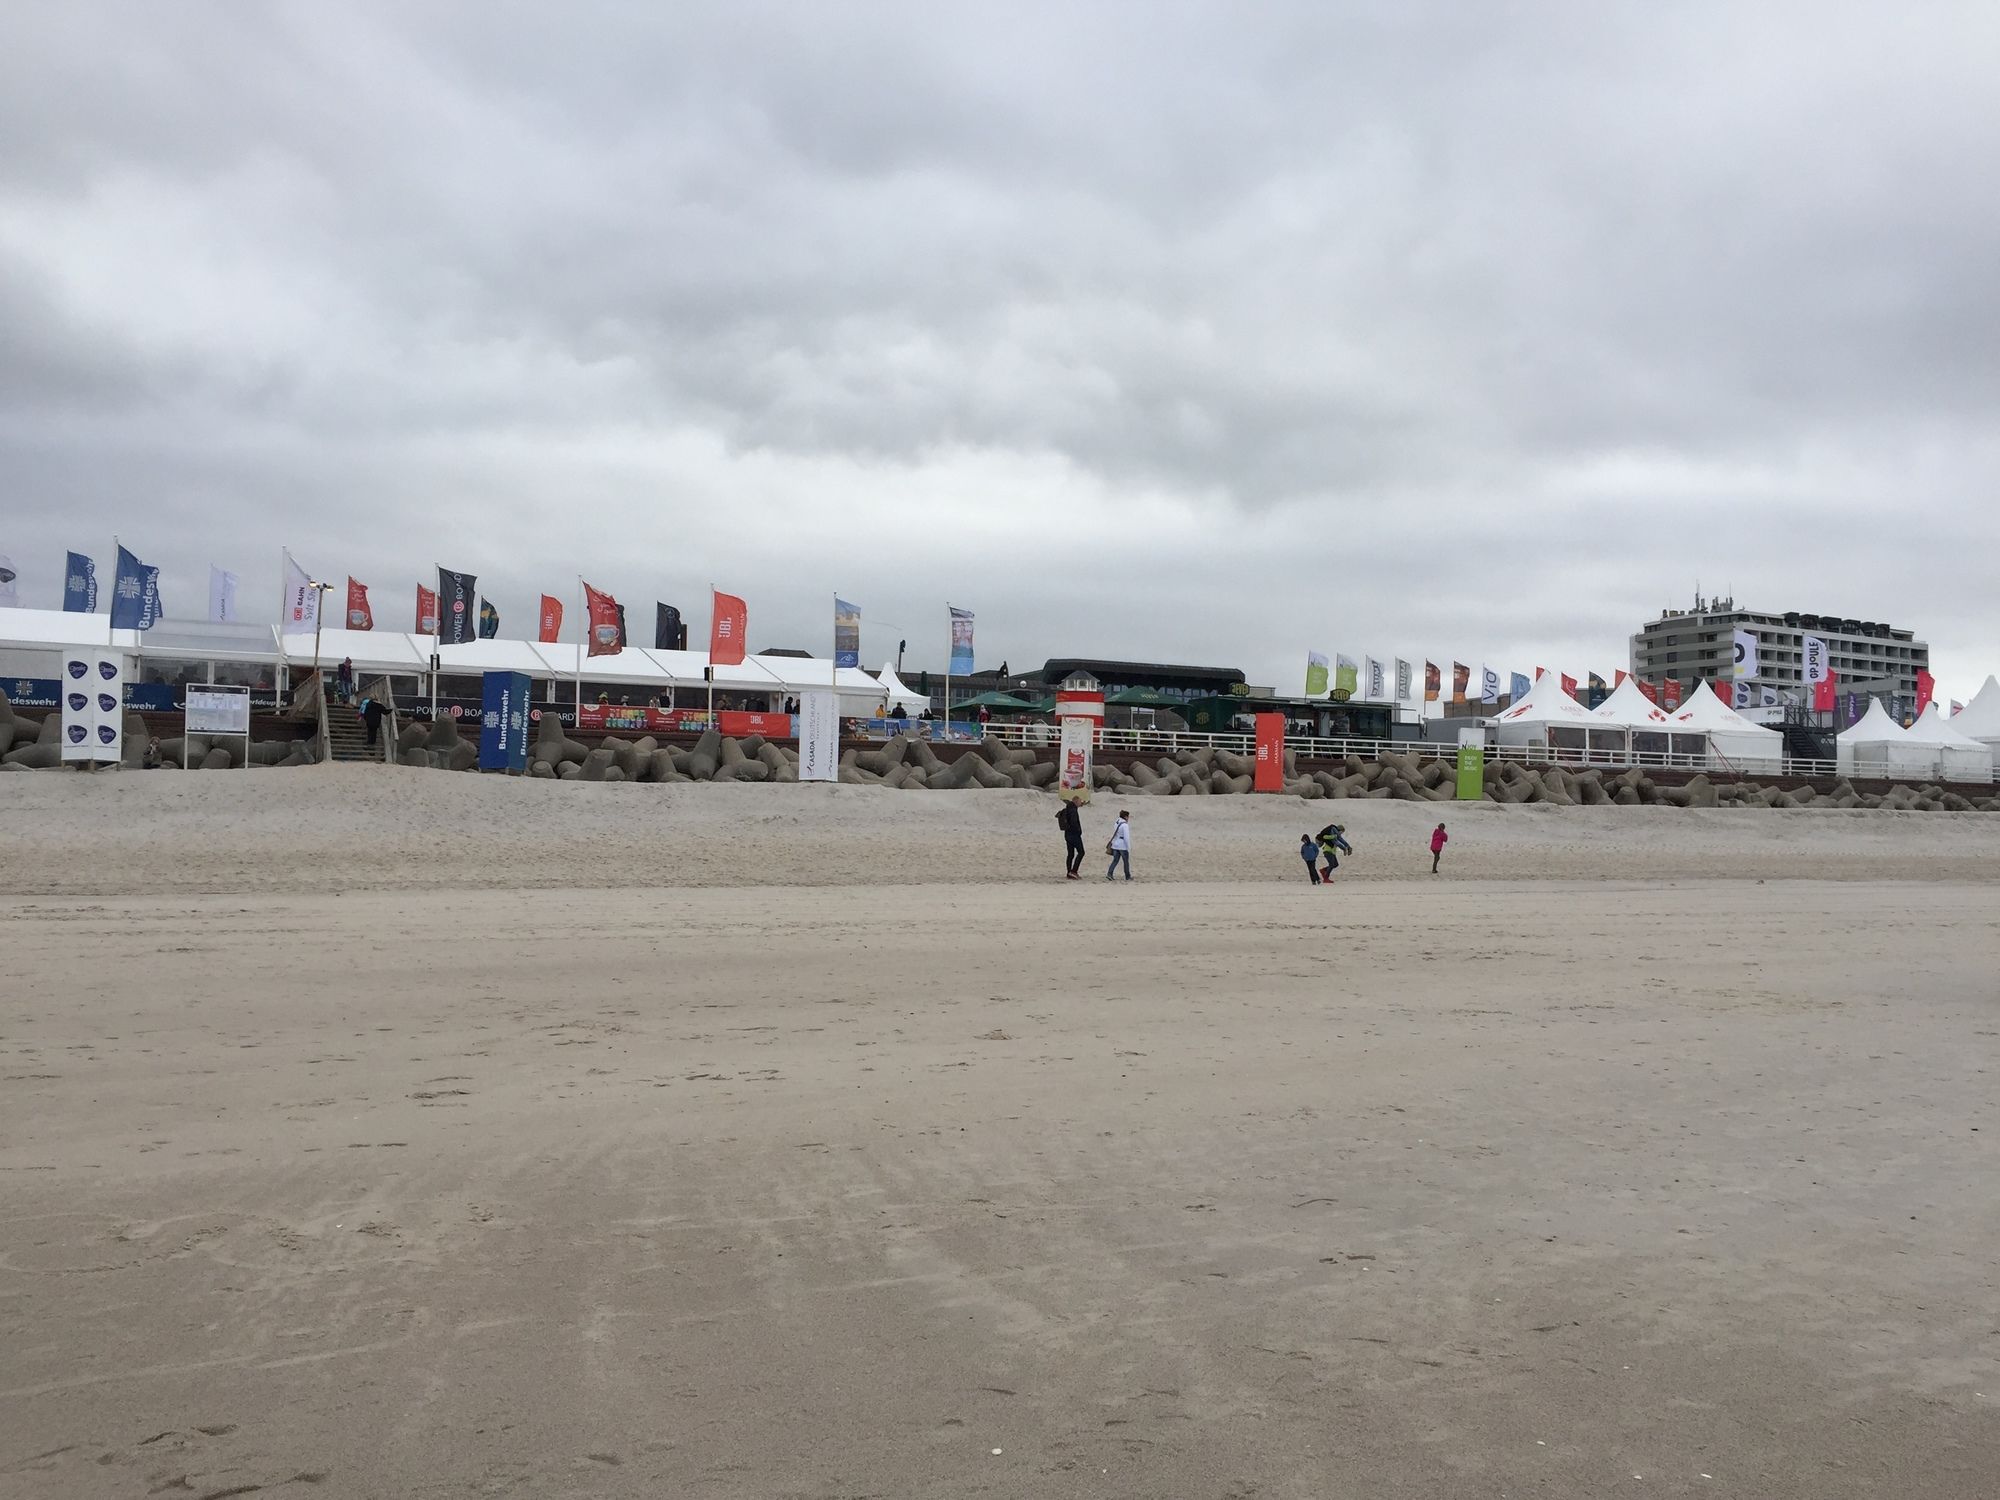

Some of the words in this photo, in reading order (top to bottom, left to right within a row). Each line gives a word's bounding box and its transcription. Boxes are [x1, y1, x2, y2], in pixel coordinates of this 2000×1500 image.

[453, 574, 463, 600] BOD
[138, 568, 160, 630] Bundesw
[304, 604, 313, 621] Sylt
[544, 613, 553, 630] JBL
[453, 613, 463, 644] POWER
[718, 617, 732, 638] JBL
[1809, 641, 1819, 667] JOULE
[1810, 667, 1819, 679] GP
[8, 697, 57, 707] ndeswehr
[498, 689, 509, 750] Bundeswehr
[520, 690, 530, 756] Bundeswehr
[750, 715, 764, 725] JBL
[808, 740, 816, 767] CASADA
[1257, 744, 1268, 760] JBL
